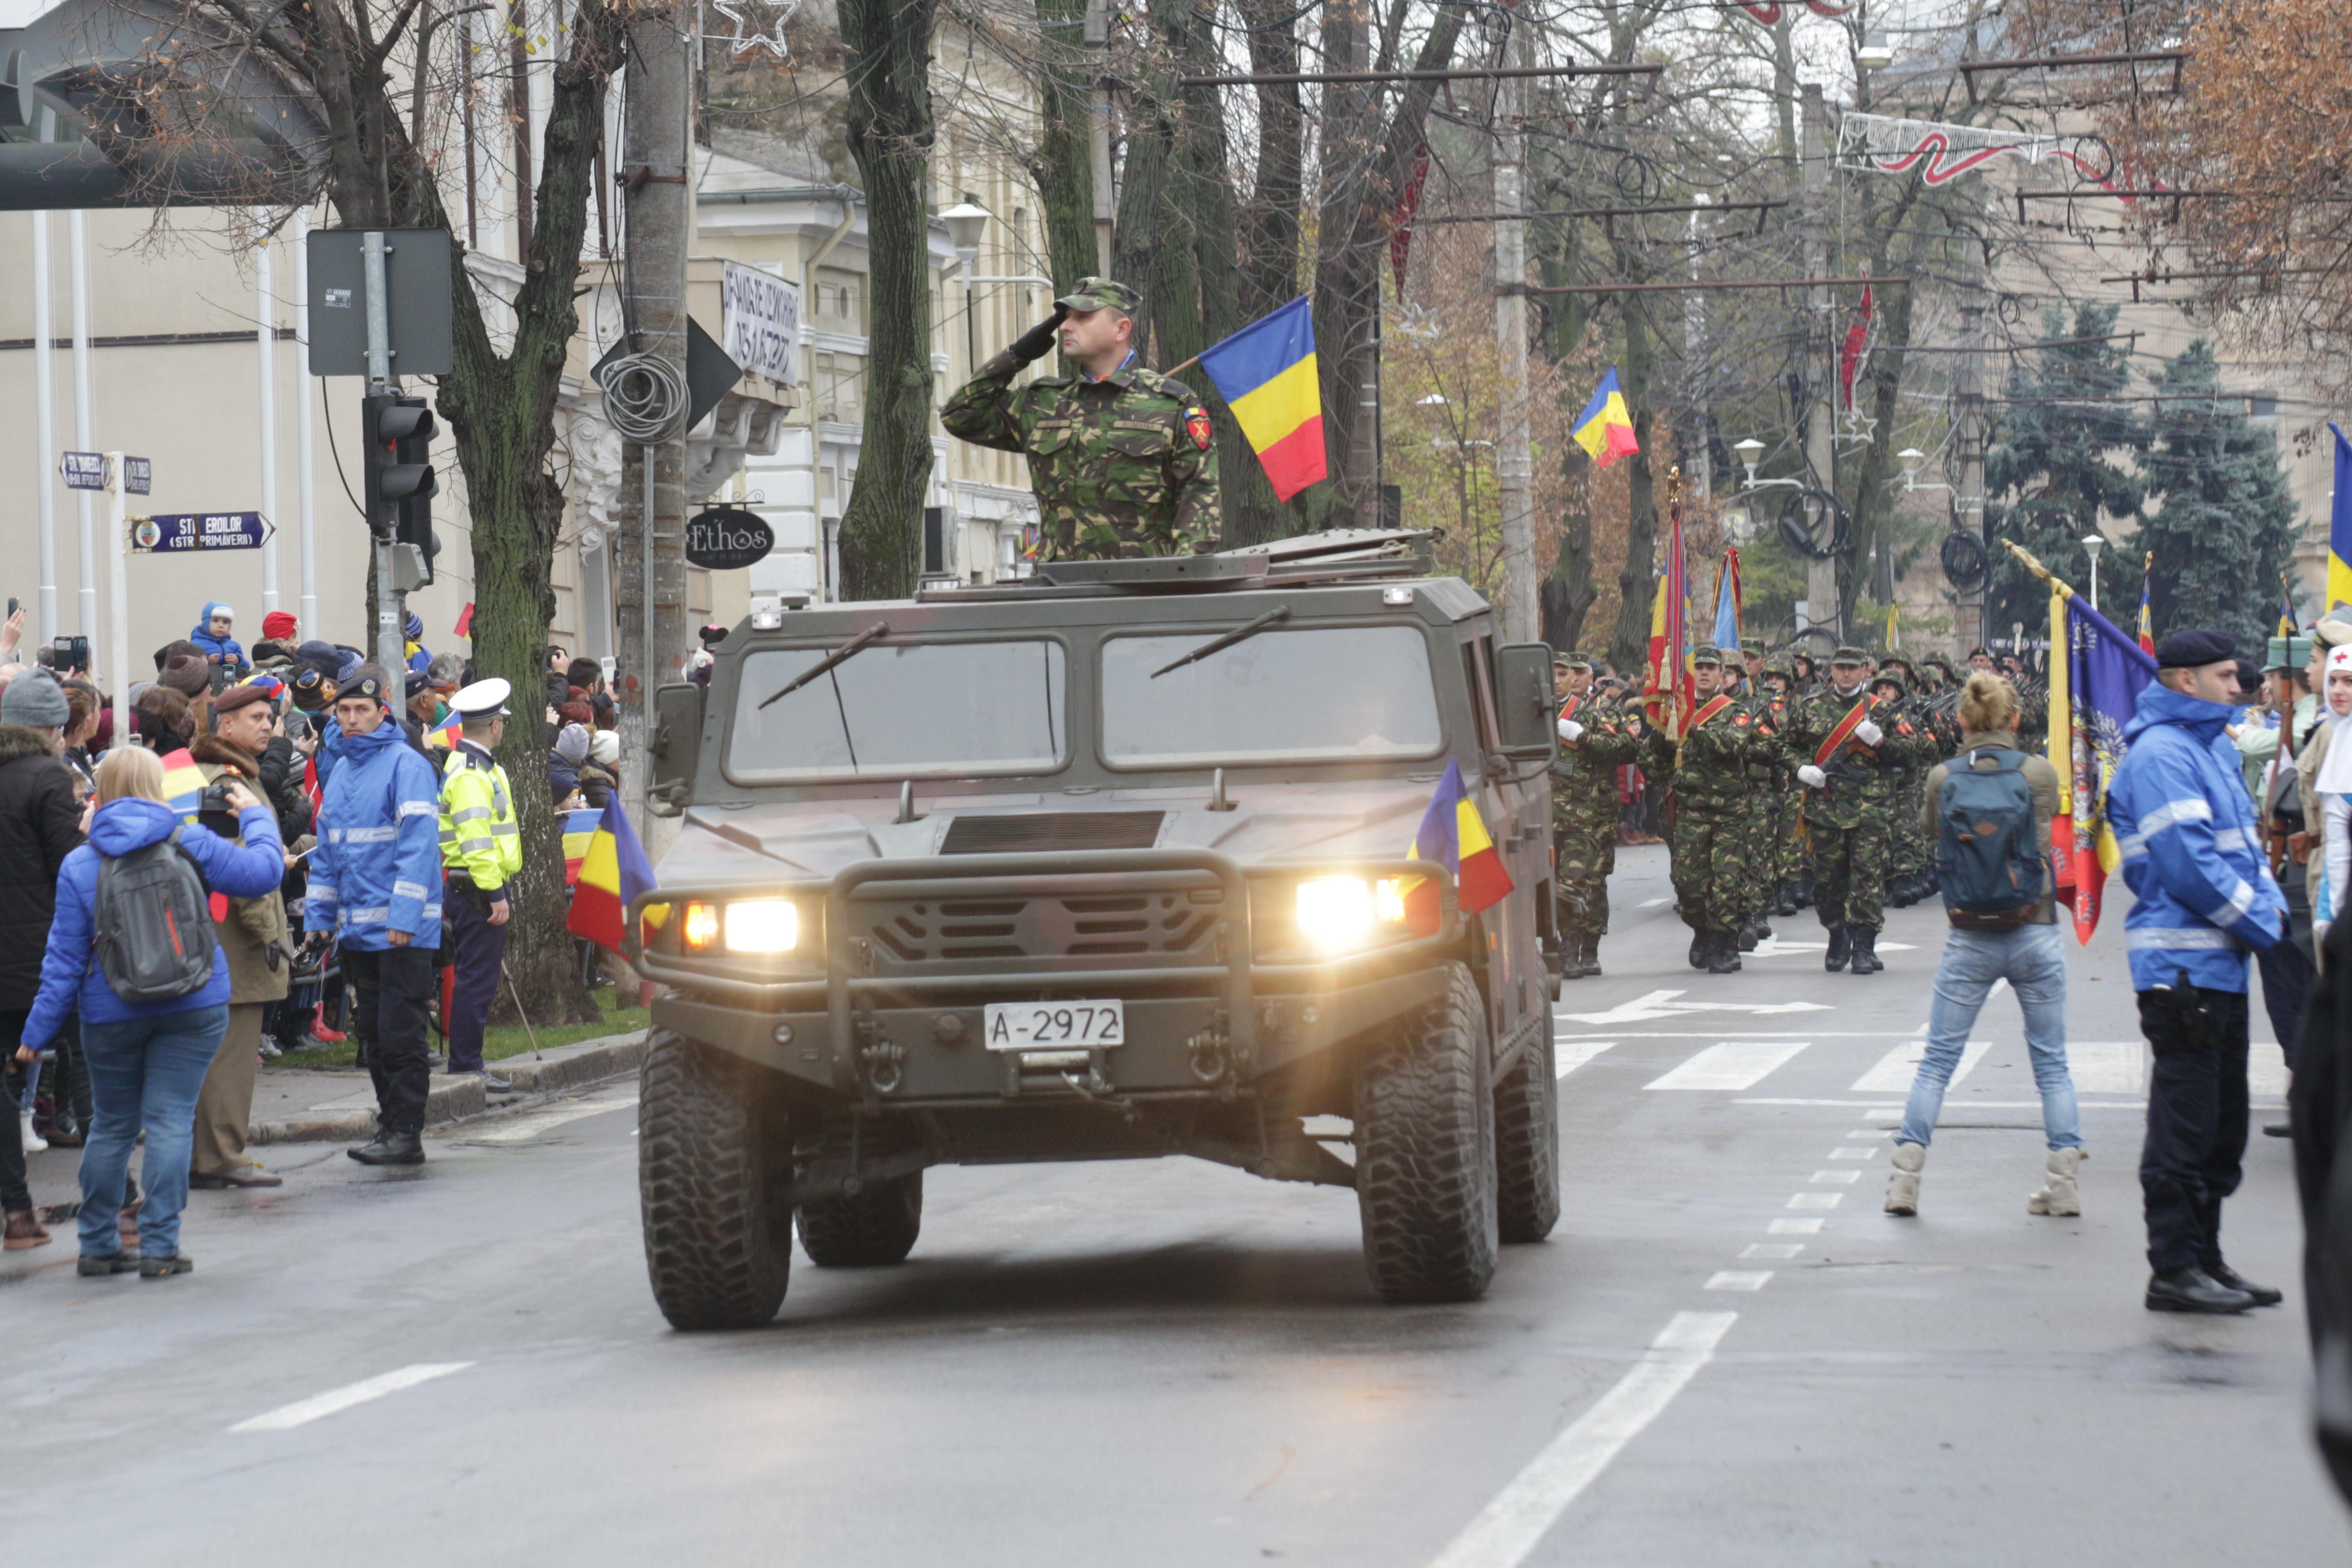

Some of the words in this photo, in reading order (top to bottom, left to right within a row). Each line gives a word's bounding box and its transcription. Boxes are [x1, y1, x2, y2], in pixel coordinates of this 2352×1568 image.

[206, 516, 242, 534] EROILOR
[691, 519, 768, 552] Ethos
[993, 1007, 1118, 1042] A-2972
